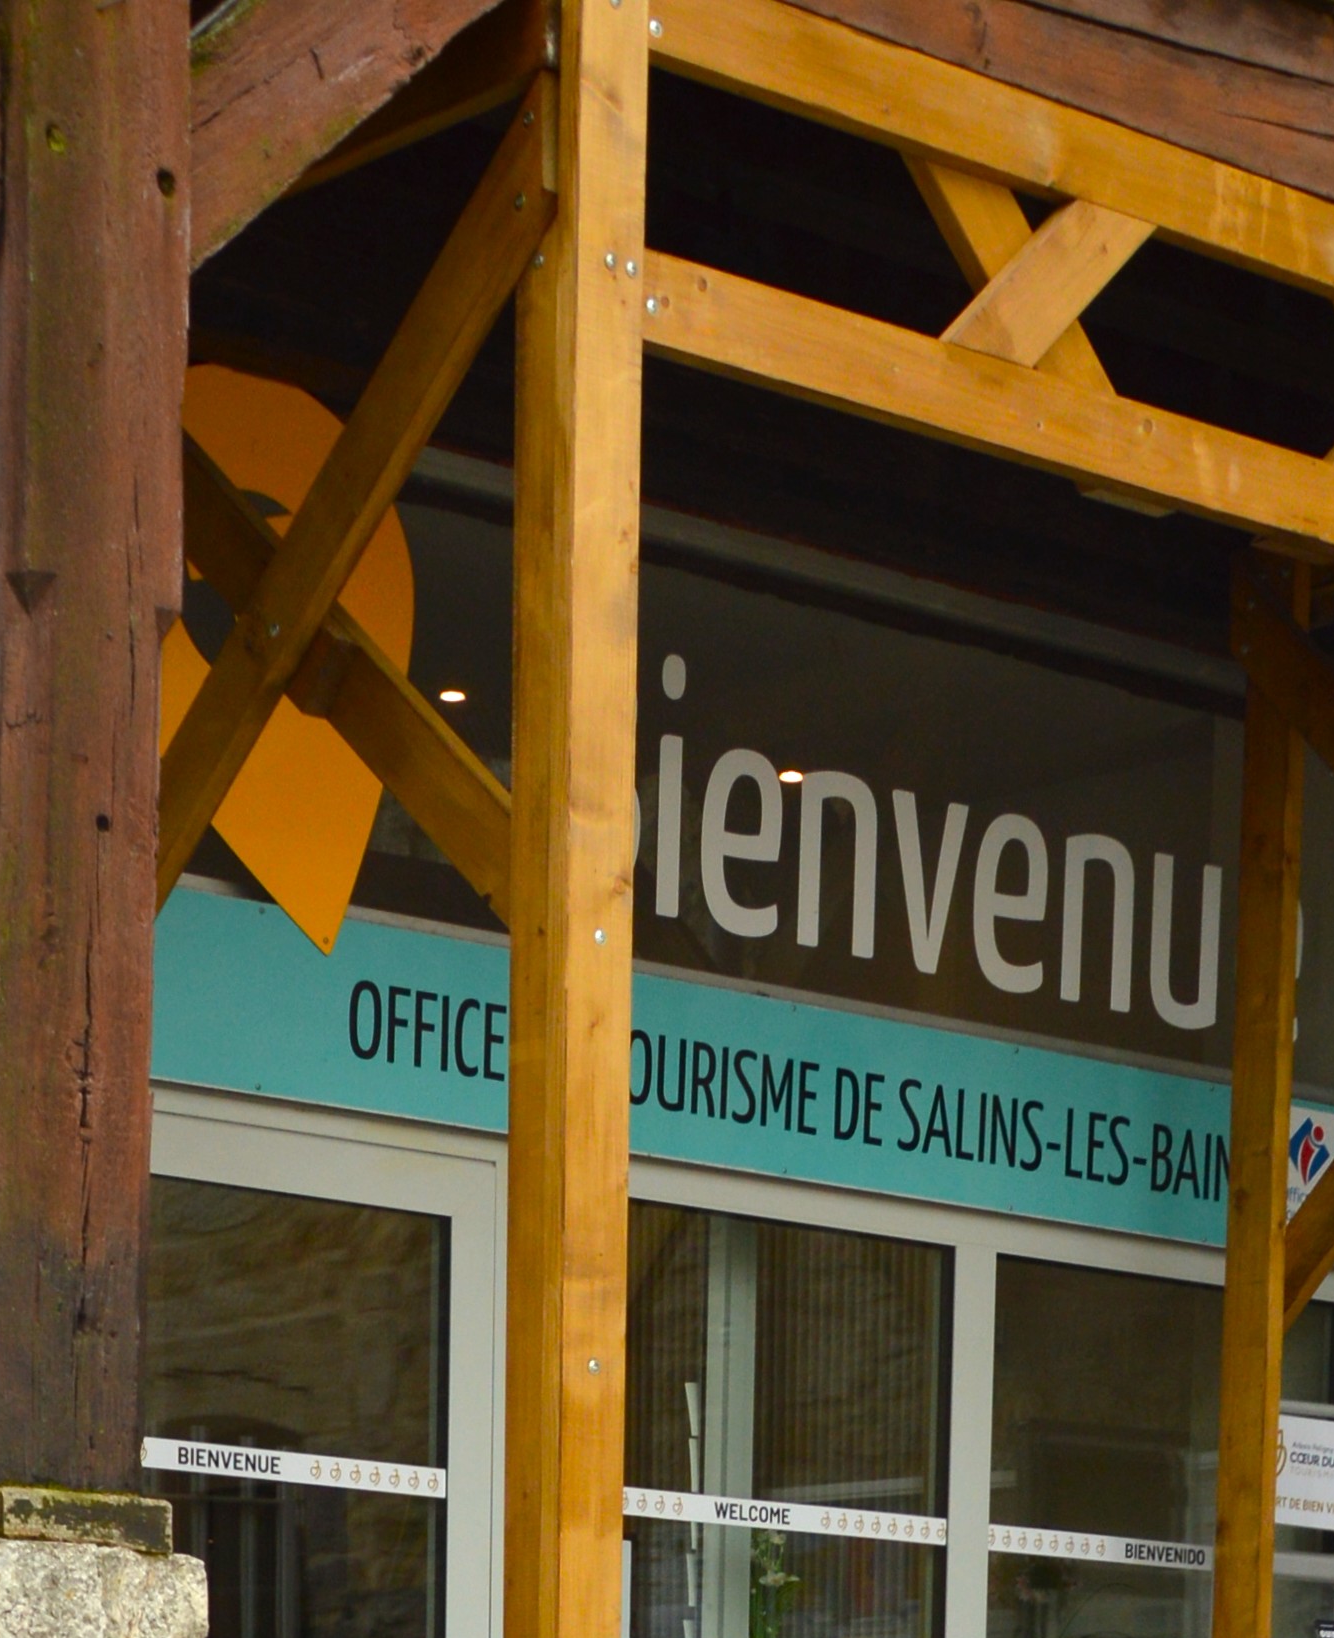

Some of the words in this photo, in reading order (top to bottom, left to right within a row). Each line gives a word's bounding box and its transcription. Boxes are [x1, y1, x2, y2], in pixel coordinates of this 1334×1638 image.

[633, 654, 1304, 1042] ienvenu
[349, 979, 507, 1082] OFFICE
[630, 1029, 820, 1136] OURISME
[833, 1067, 885, 1147] DE
[897, 1078, 1231, 1202] SALINS-LES-BAIN
[177, 1446, 282, 1475] BIENVENUE
[714, 1501, 791, 1525] WELCOME
[1289, 1497, 1301, 1510] DE
[1302, 1498, 1325, 1513] BIEN
[1124, 1543, 1206, 1566] BIENVENIDO
